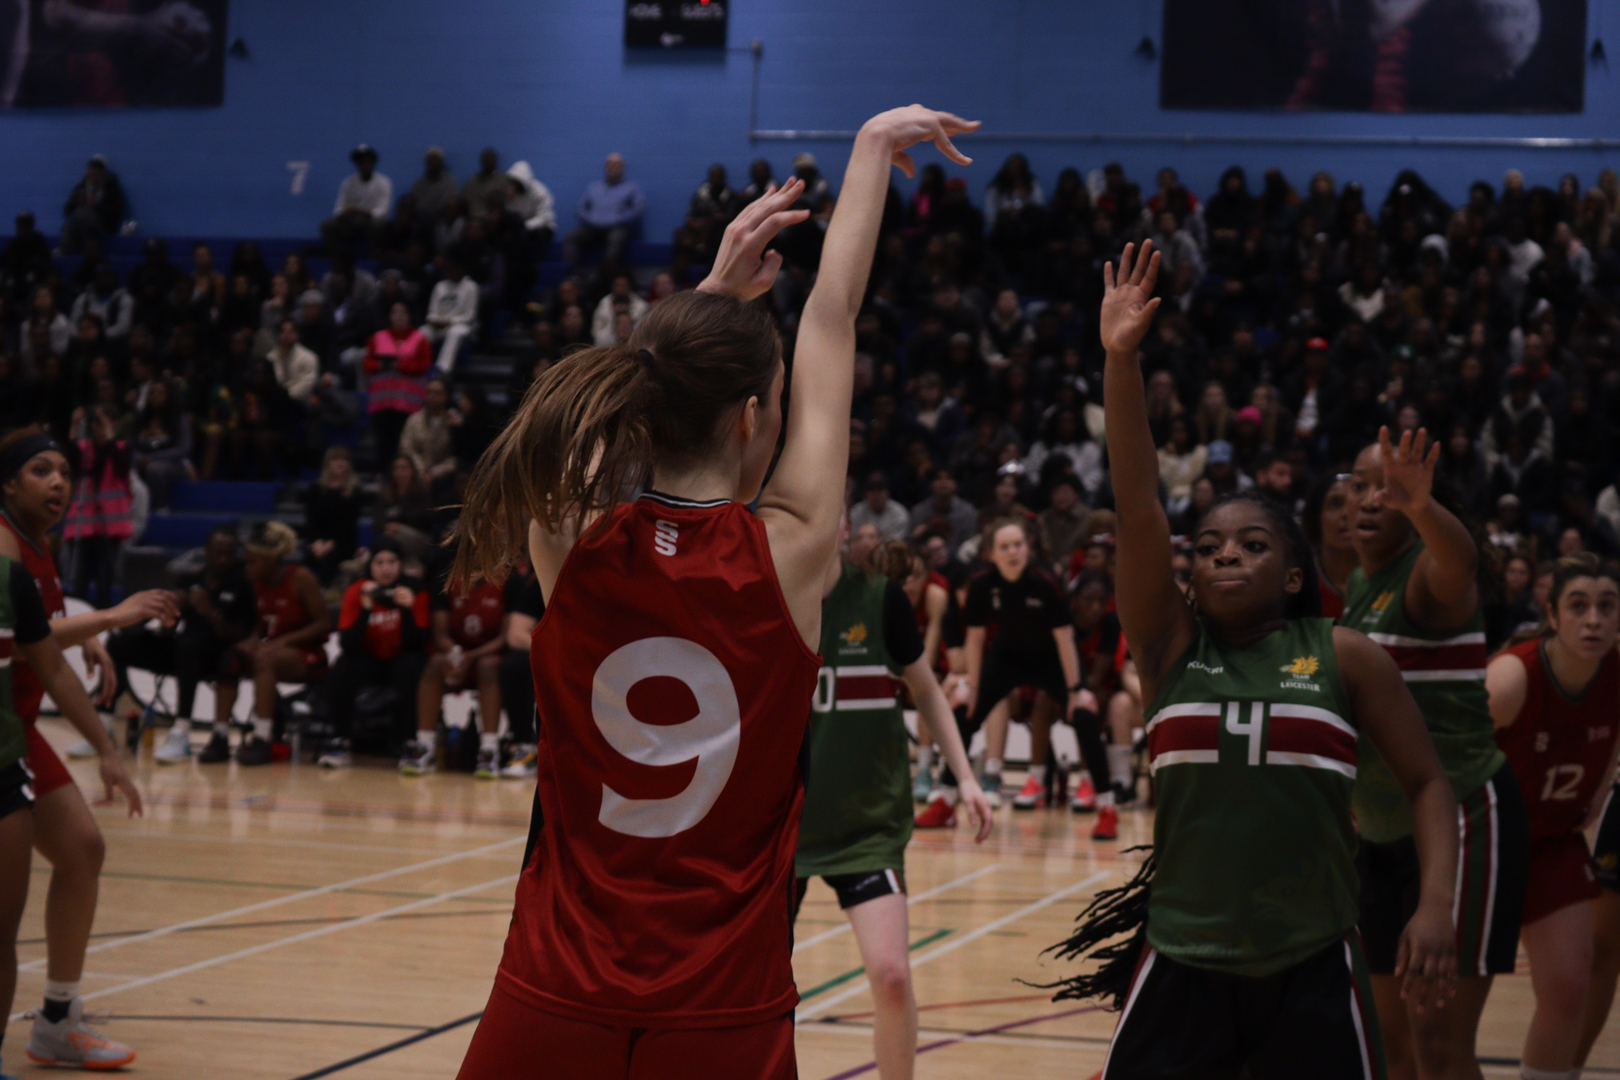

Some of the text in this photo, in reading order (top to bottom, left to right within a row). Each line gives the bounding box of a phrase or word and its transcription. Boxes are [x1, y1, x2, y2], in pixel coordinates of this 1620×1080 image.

[286, 161, 309, 195] 7
[1280, 681, 1320, 691] LEICESTER
[591, 636, 741, 838] 9
[1225, 701, 1264, 766] 4
[1540, 764, 1584, 801] 12
